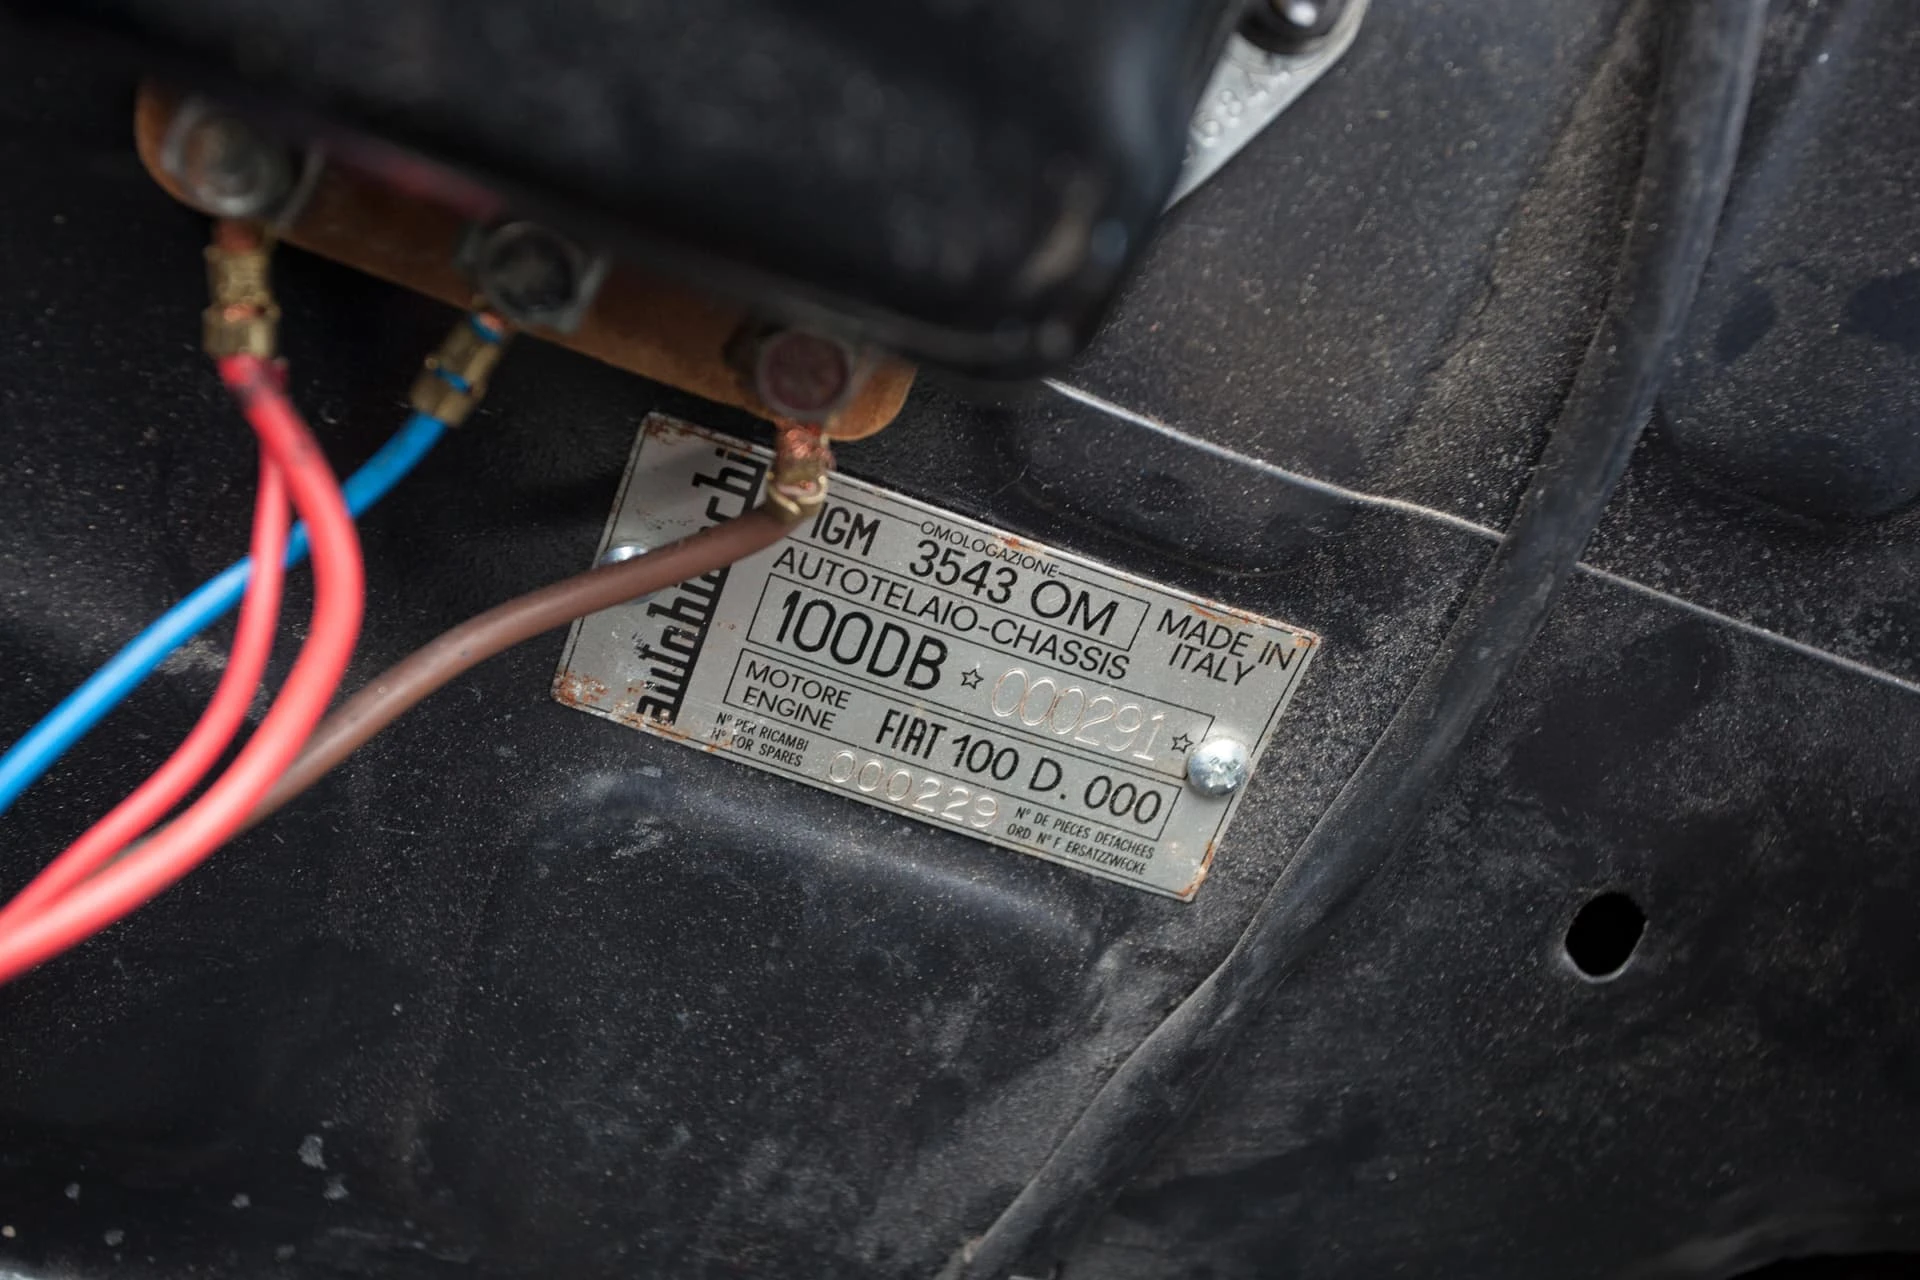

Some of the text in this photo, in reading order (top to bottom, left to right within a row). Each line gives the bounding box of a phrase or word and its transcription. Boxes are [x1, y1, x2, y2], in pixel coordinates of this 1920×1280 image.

[810, 502, 1120, 637] IGM 3543 OM
[920, 520, 1060, 578] OMOLOGAZIONE
[772, 546, 1130, 681] AUTOTELAIO-CHASSIS
[1157, 608, 1297, 671] MADE IN
[745, 660, 852, 710] MOTORE
[775, 590, 1165, 761] 100DB 000291
[1168, 643, 1256, 686] ITALY
[735, 718, 757, 735] PER
[759, 726, 809, 752] RICAMBI
[742, 686, 836, 731] ENGINE
[730, 734, 754, 751] FOR
[759, 743, 804, 767] SPARES
[876, 708, 947, 760] FIAT
[951, 734, 1019, 781] 100
[1083, 775, 1163, 825] 000
[828, 751, 998, 828] 000229
[1034, 812, 1050, 827] DE
[1053, 817, 1091, 840] PIECES
[1094, 831, 1155, 860] DETACHEES
[1065, 840, 1147, 876] ERSATZZWECKE
